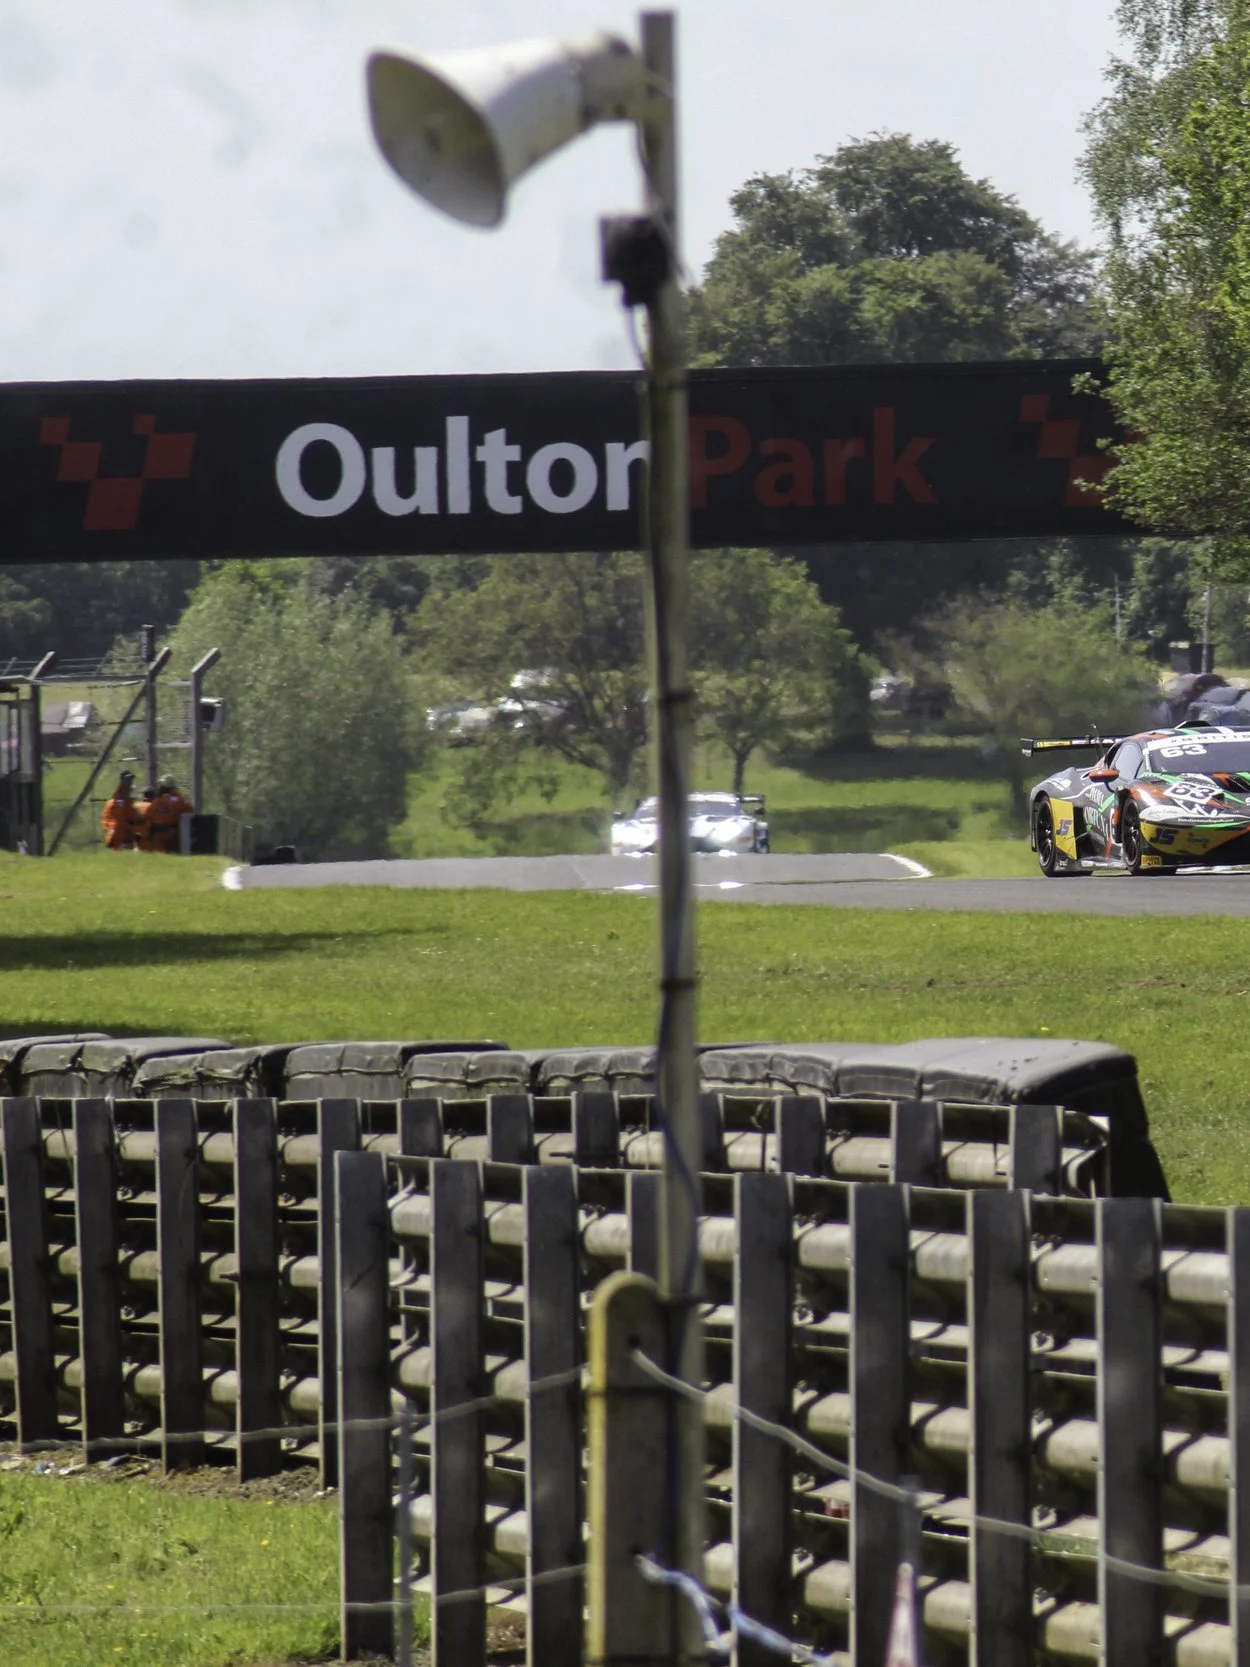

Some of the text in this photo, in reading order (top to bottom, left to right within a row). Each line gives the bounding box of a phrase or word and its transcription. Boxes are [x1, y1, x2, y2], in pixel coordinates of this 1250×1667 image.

[690, 408, 941, 509] Park
[1160, 744, 1208, 758] 63
[1170, 782, 1216, 800] 63
[1056, 819, 1072, 836] JS
[1149, 828, 1179, 845] JS
